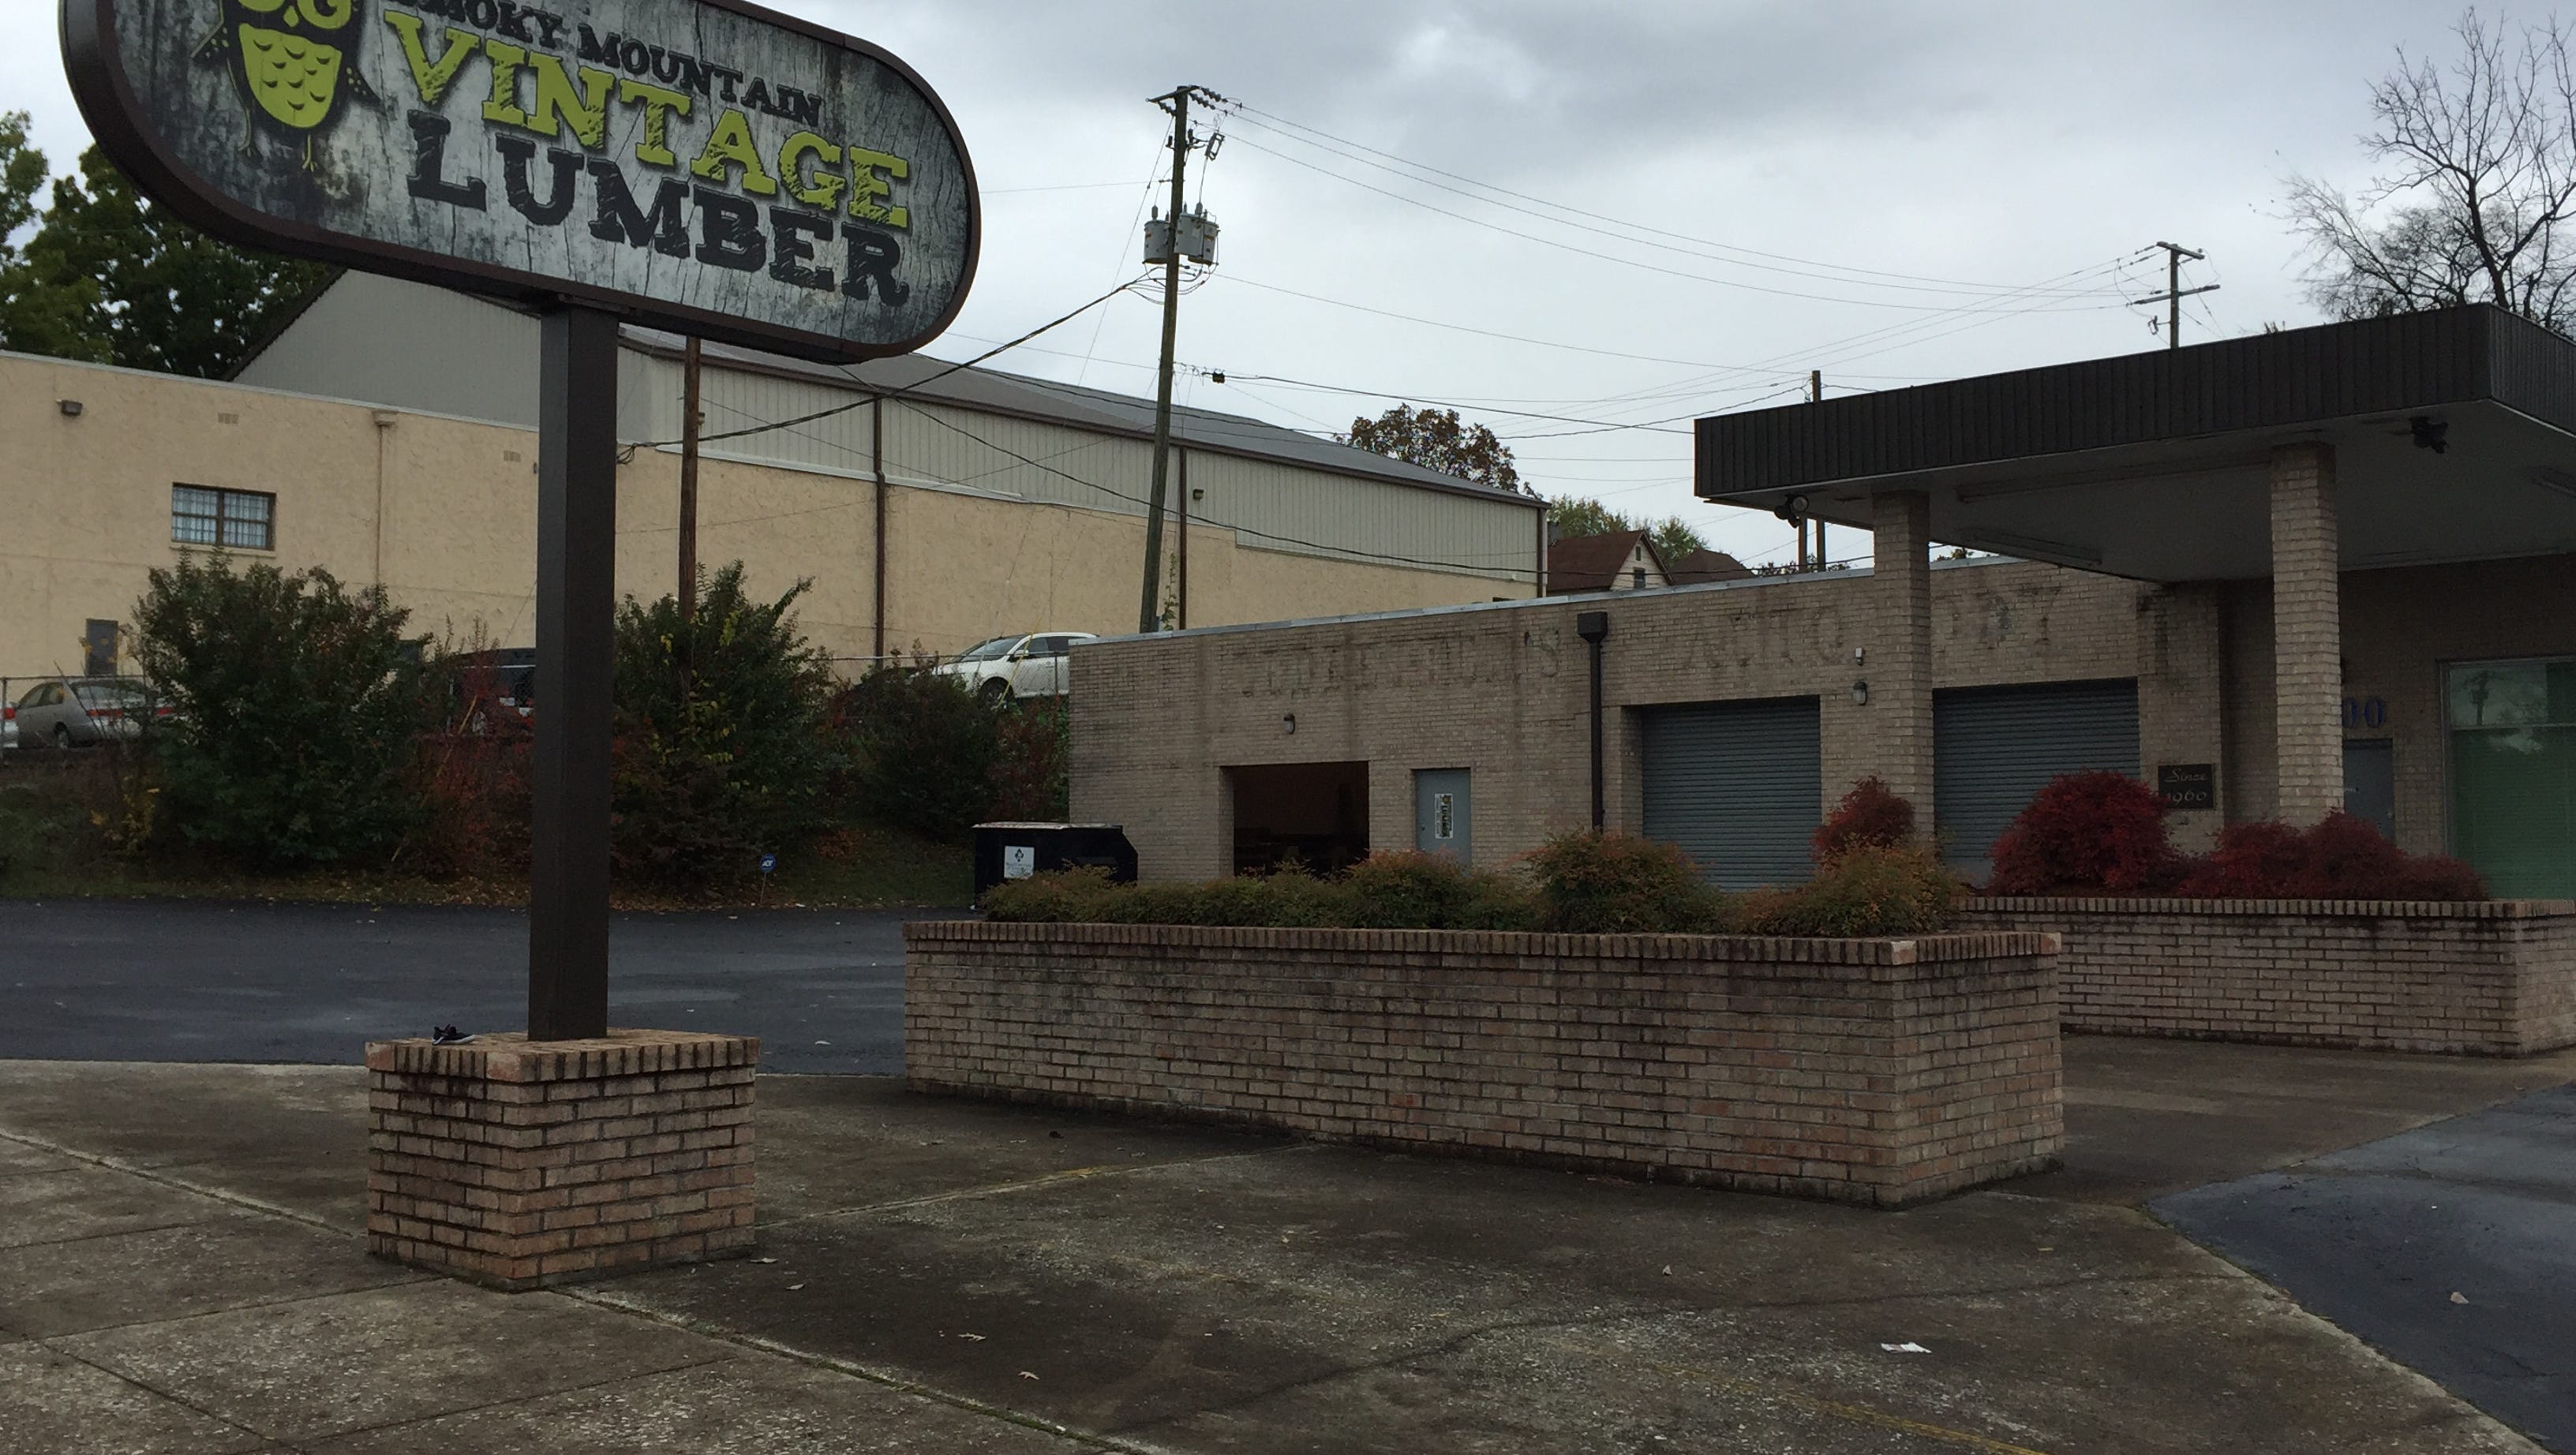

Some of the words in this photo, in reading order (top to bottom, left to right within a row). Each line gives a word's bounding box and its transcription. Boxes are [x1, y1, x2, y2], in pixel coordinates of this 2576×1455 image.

[384, 9, 908, 228] VINTAGE
[577, 23, 824, 127] MOUNTAIN
[406, 109, 910, 307] LUMBER
[2164, 768, 2207, 783] Since
[2165, 789, 2207, 806] 1960
